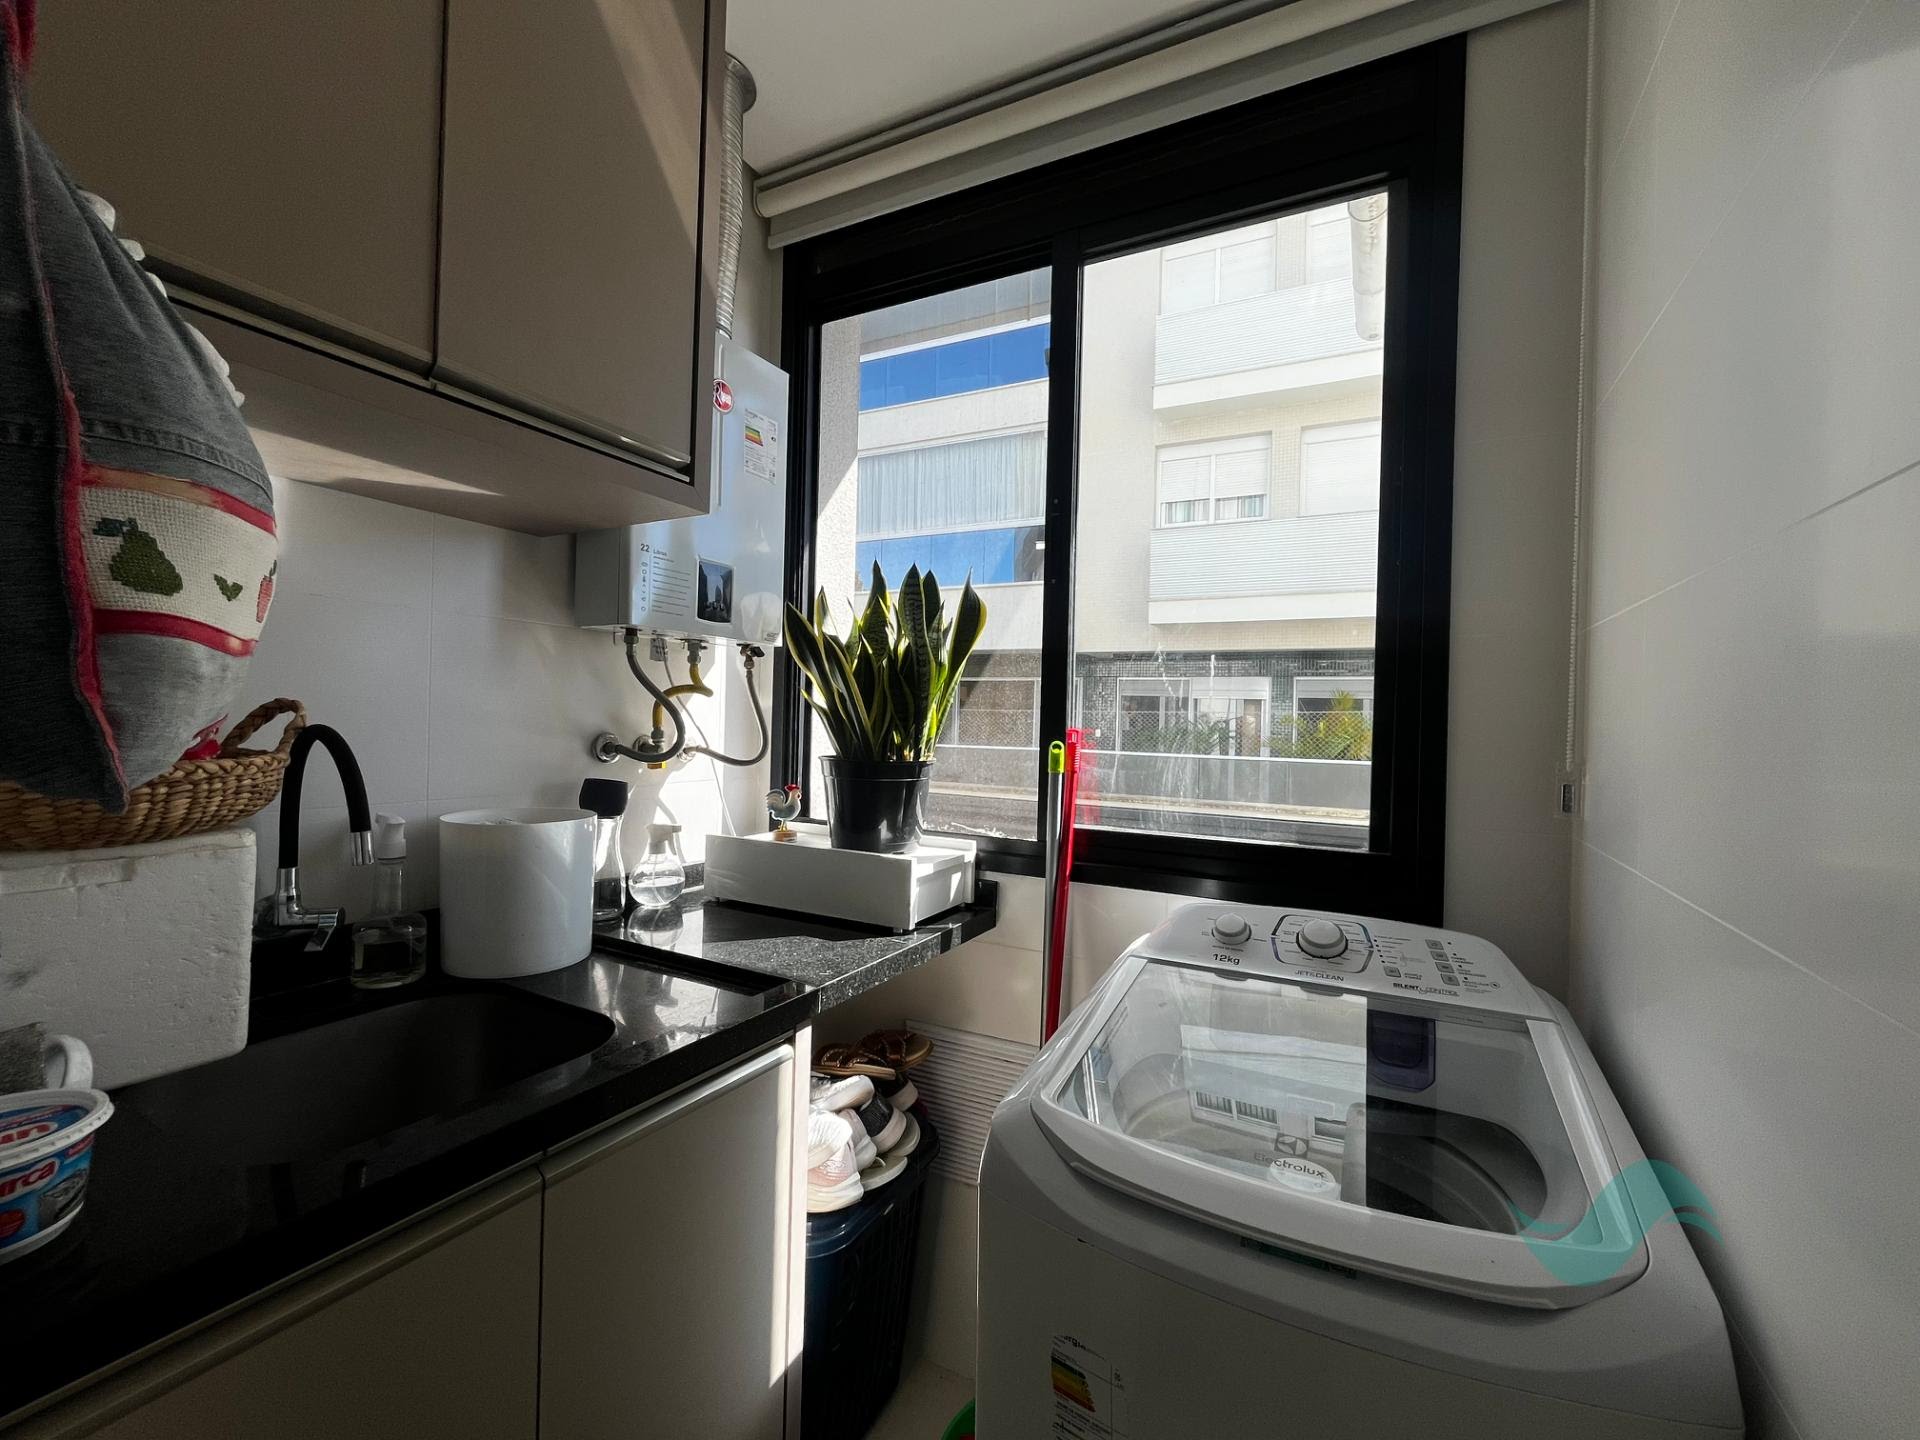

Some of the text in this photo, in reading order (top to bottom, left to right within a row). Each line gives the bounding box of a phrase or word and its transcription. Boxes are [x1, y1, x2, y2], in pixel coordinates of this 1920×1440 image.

[640, 543, 650, 552] 22
[1213, 953, 1240, 965] 12kg
[1393, 982, 1419, 991] SILENT
